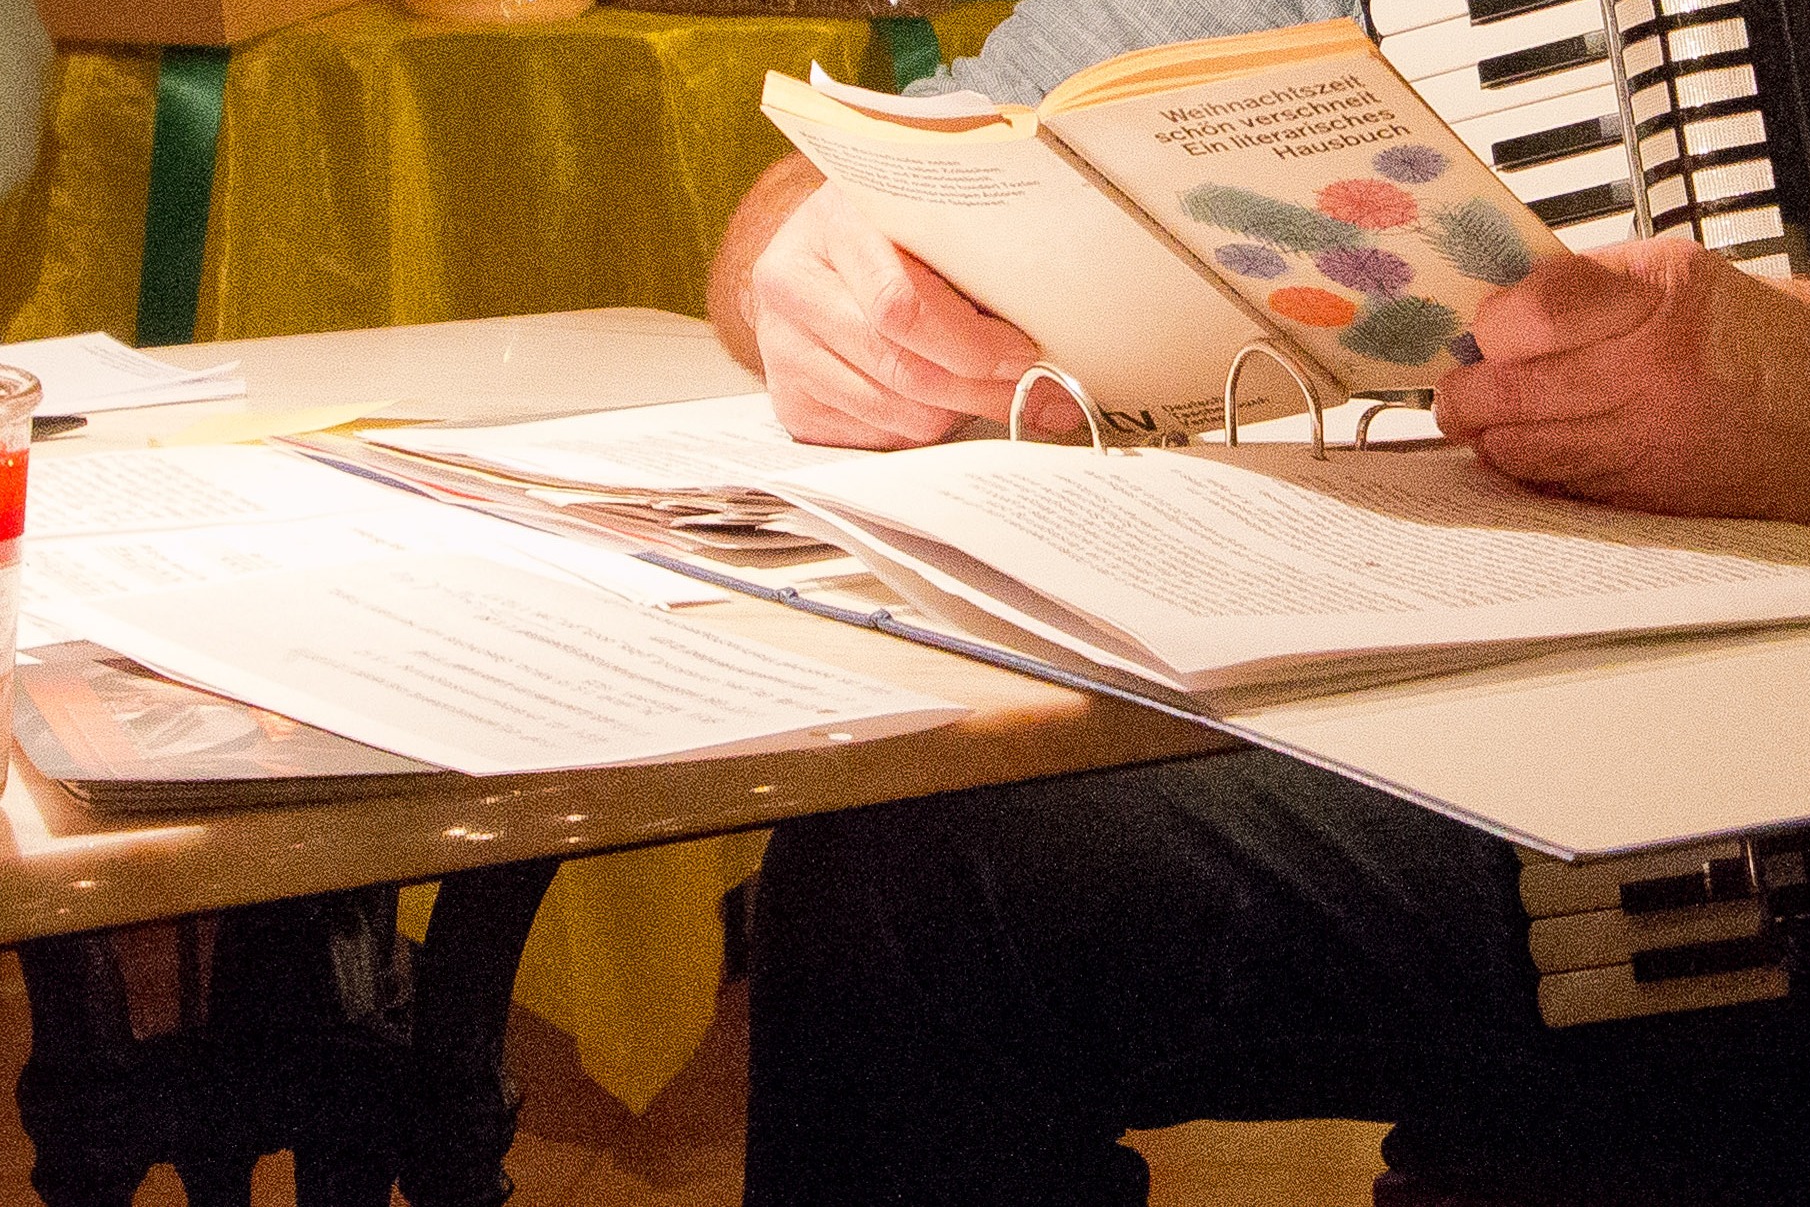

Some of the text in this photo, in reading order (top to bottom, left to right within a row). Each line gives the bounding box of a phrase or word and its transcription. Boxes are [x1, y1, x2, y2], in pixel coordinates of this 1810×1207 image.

[1153, 90, 1384, 145] schön verschneit
[1158, 73, 1368, 125] Weihnachtszeit
[1181, 108, 1398, 158] Ein literarisches
[1270, 122, 1412, 161] Hausbuch
[1098, 403, 1158, 435] tv
